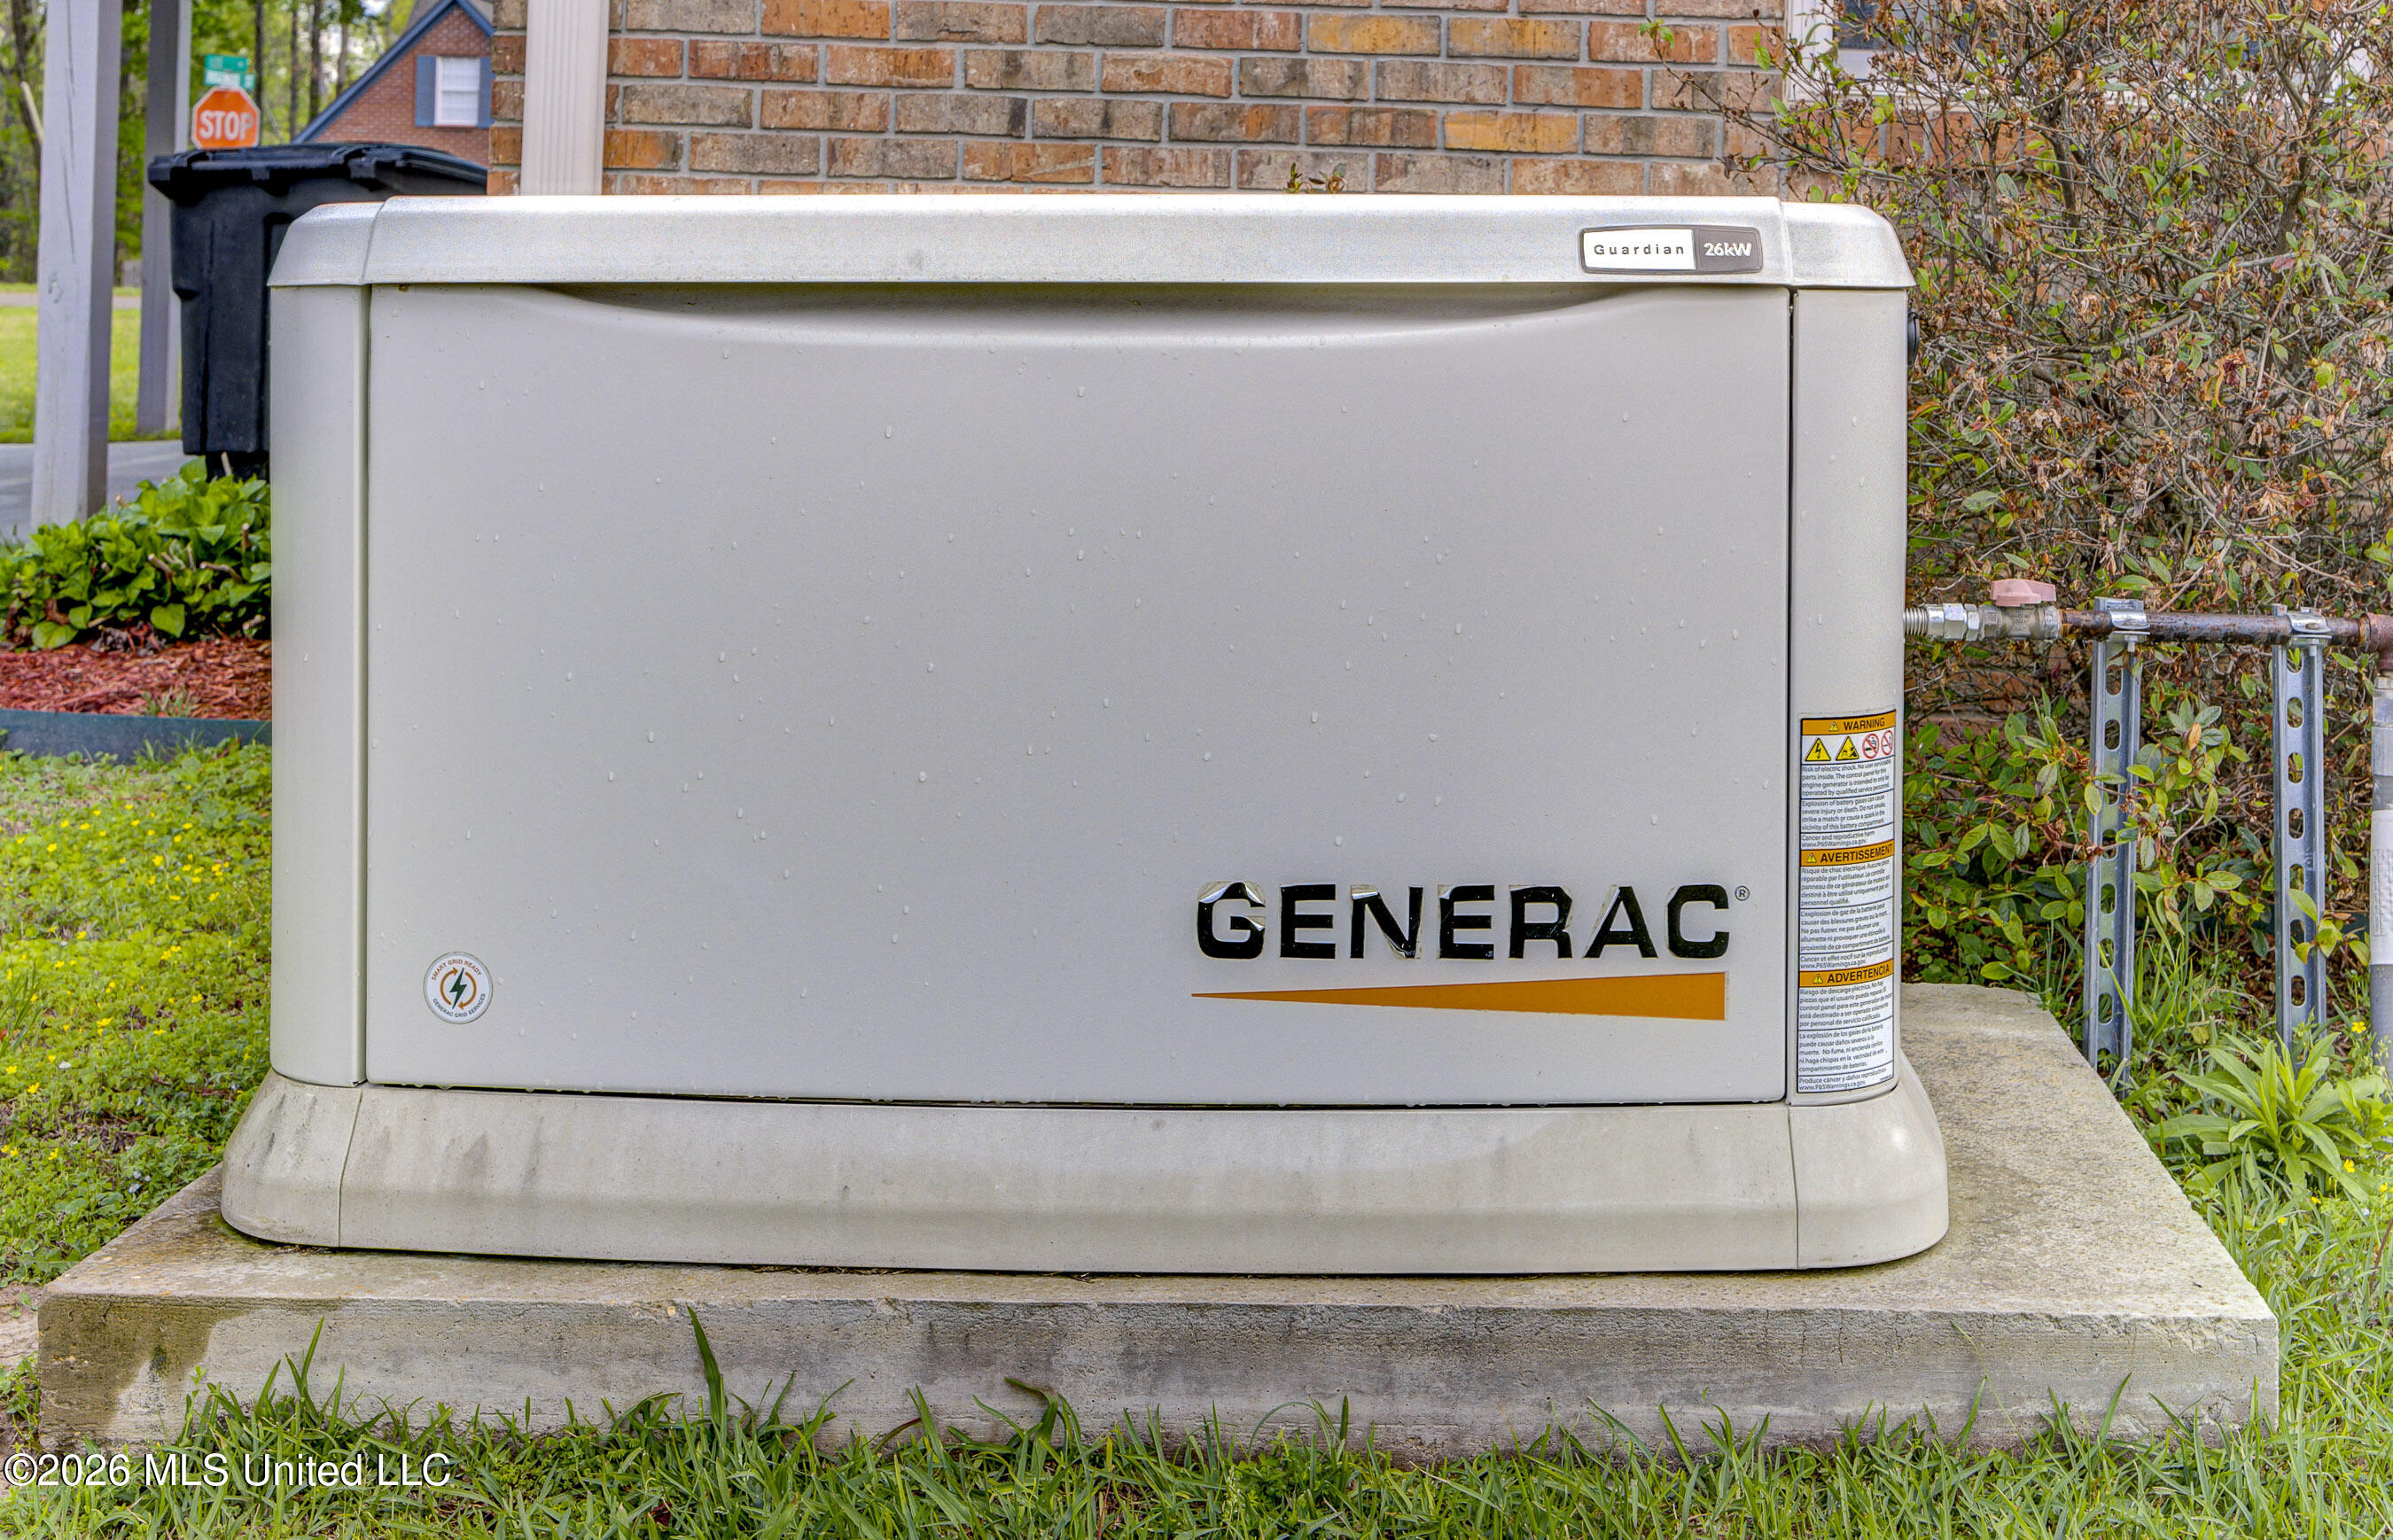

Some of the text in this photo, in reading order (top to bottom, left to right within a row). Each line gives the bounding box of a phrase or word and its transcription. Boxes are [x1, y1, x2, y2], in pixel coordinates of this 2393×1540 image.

[199, 110, 254, 141] STOP
[1594, 242, 1752, 257] Guardian 26kW
[1843, 717, 1885, 731] WARNING
[1820, 844, 1893, 863] AVERTISSEMENT
[1197, 882, 1729, 959] GENERAC
[432, 962, 447, 981] SMART
[464, 961, 482, 976] READY
[1828, 963, 1890, 984] ADVERTENCIA
[433, 998, 454, 1017] GENERAC
